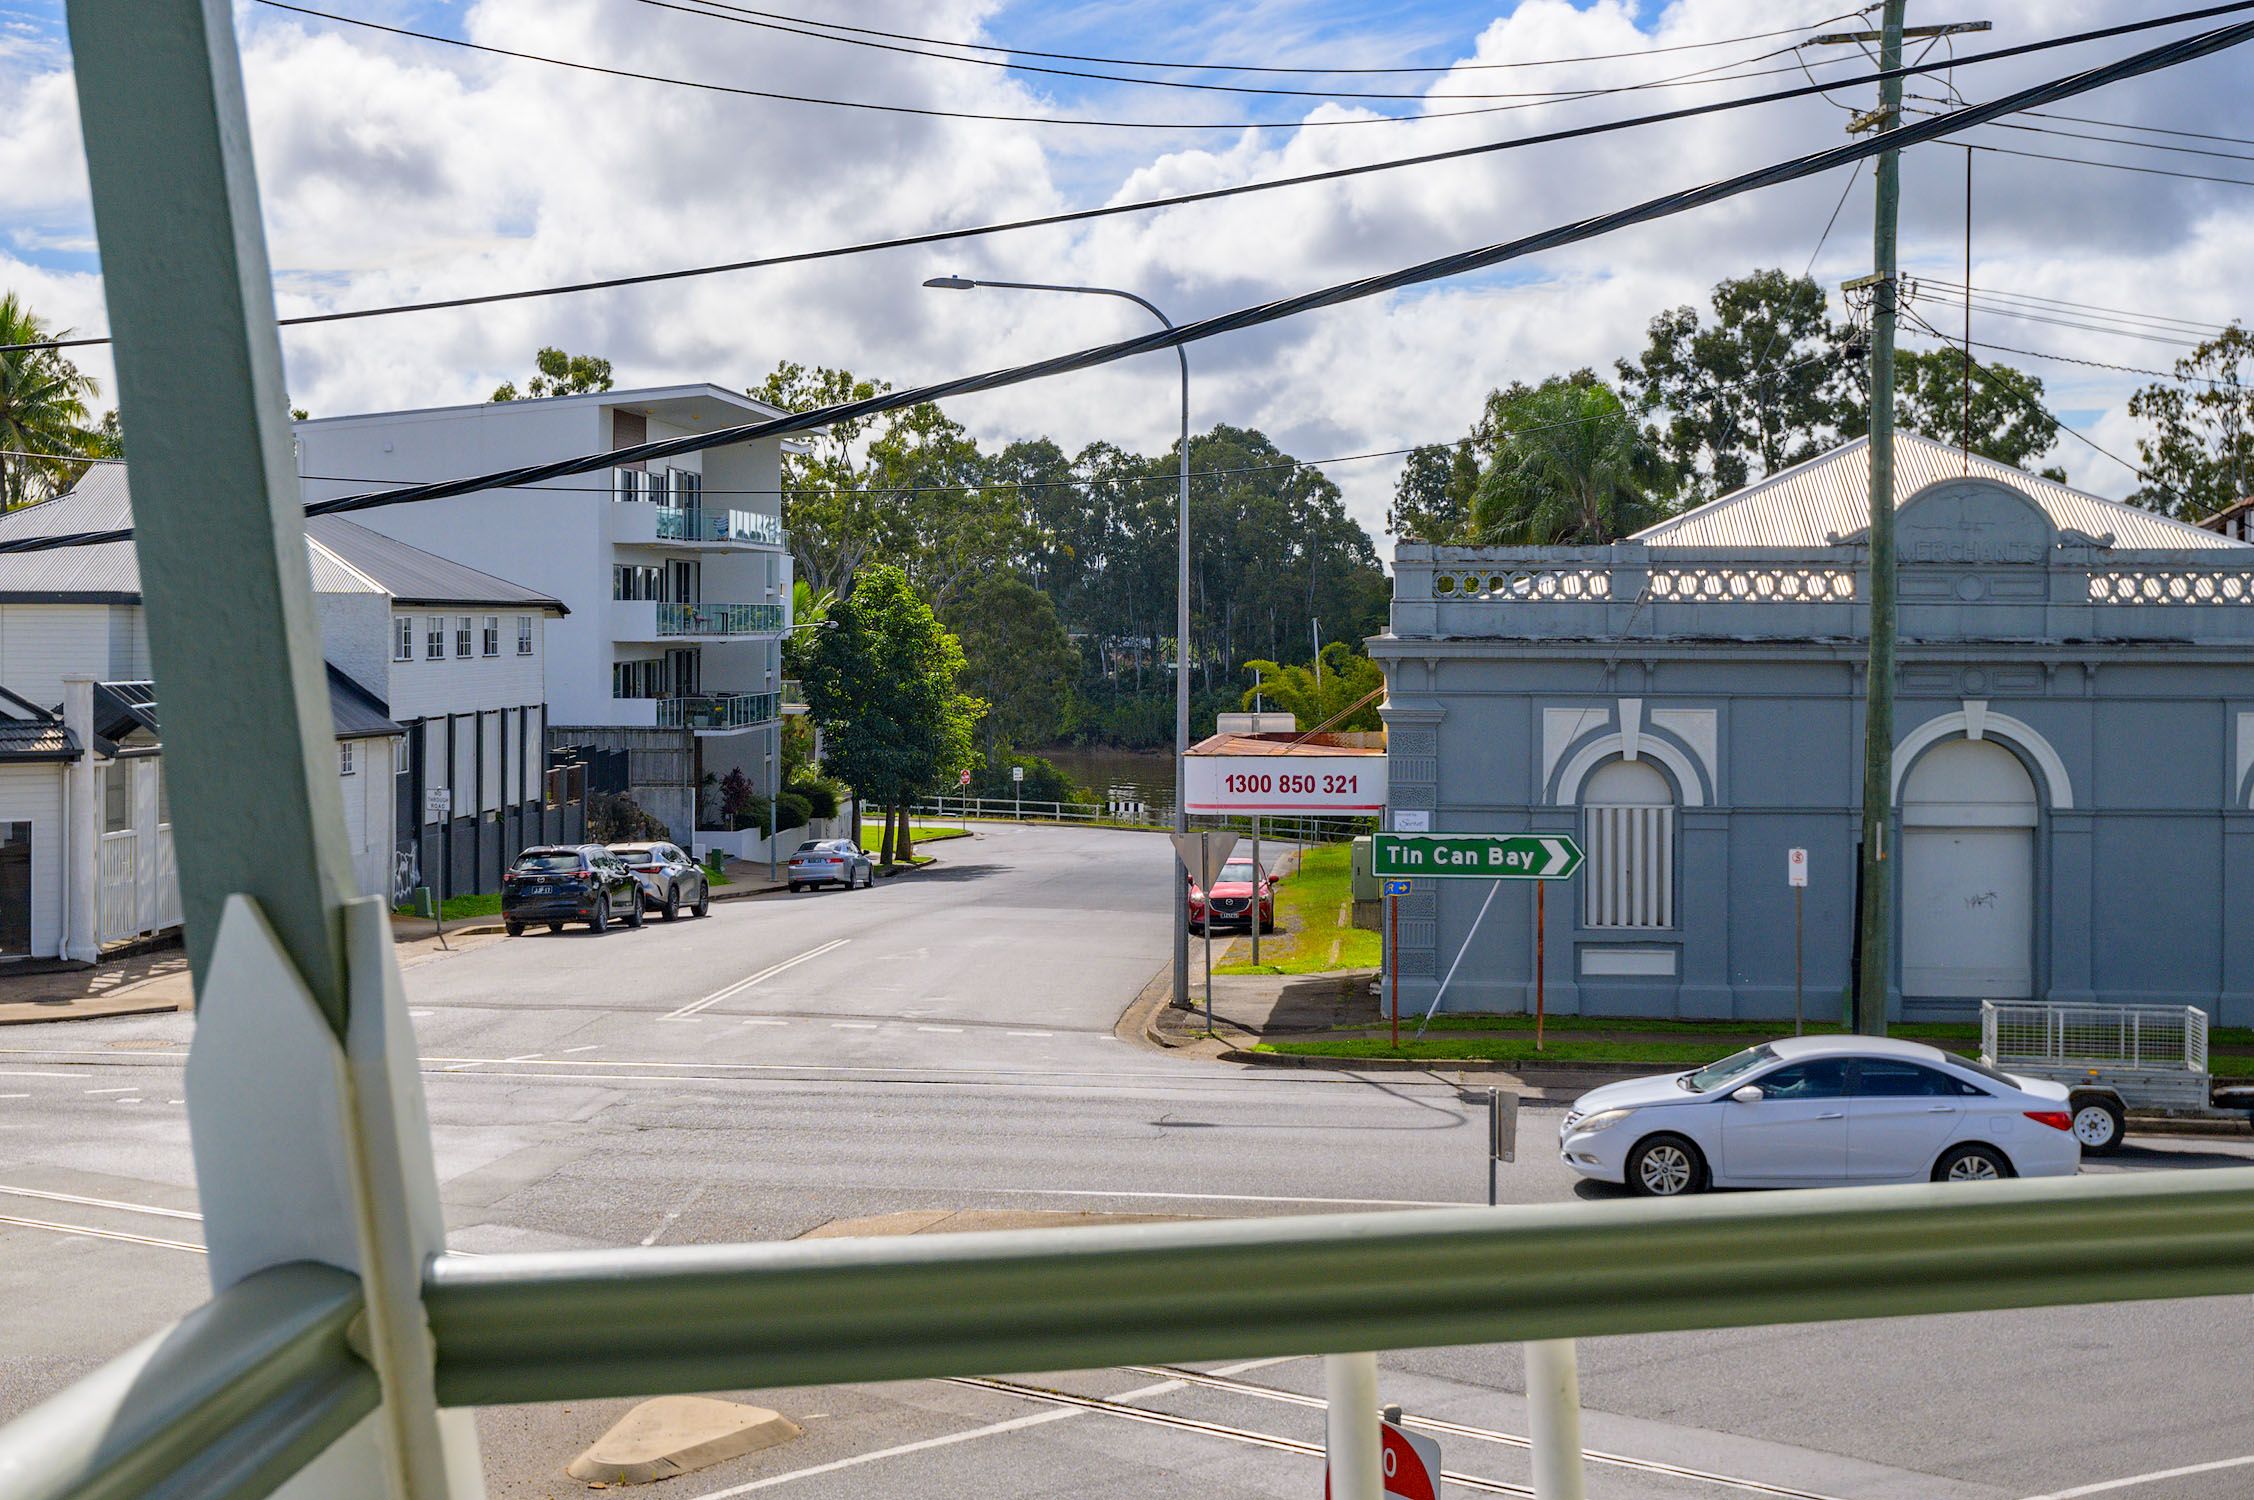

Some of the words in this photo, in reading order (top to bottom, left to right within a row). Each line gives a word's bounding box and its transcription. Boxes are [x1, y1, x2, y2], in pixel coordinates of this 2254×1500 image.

[1895, 541, 2043, 562] MERCHANTS
[1225, 774, 1272, 793] 1300
[1279, 775, 1316, 794] 850
[1322, 775, 1358, 794] 321
[1386, 845, 1423, 865] Tin
[1433, 846, 1479, 866] Can
[1488, 847, 1535, 870] Bay
